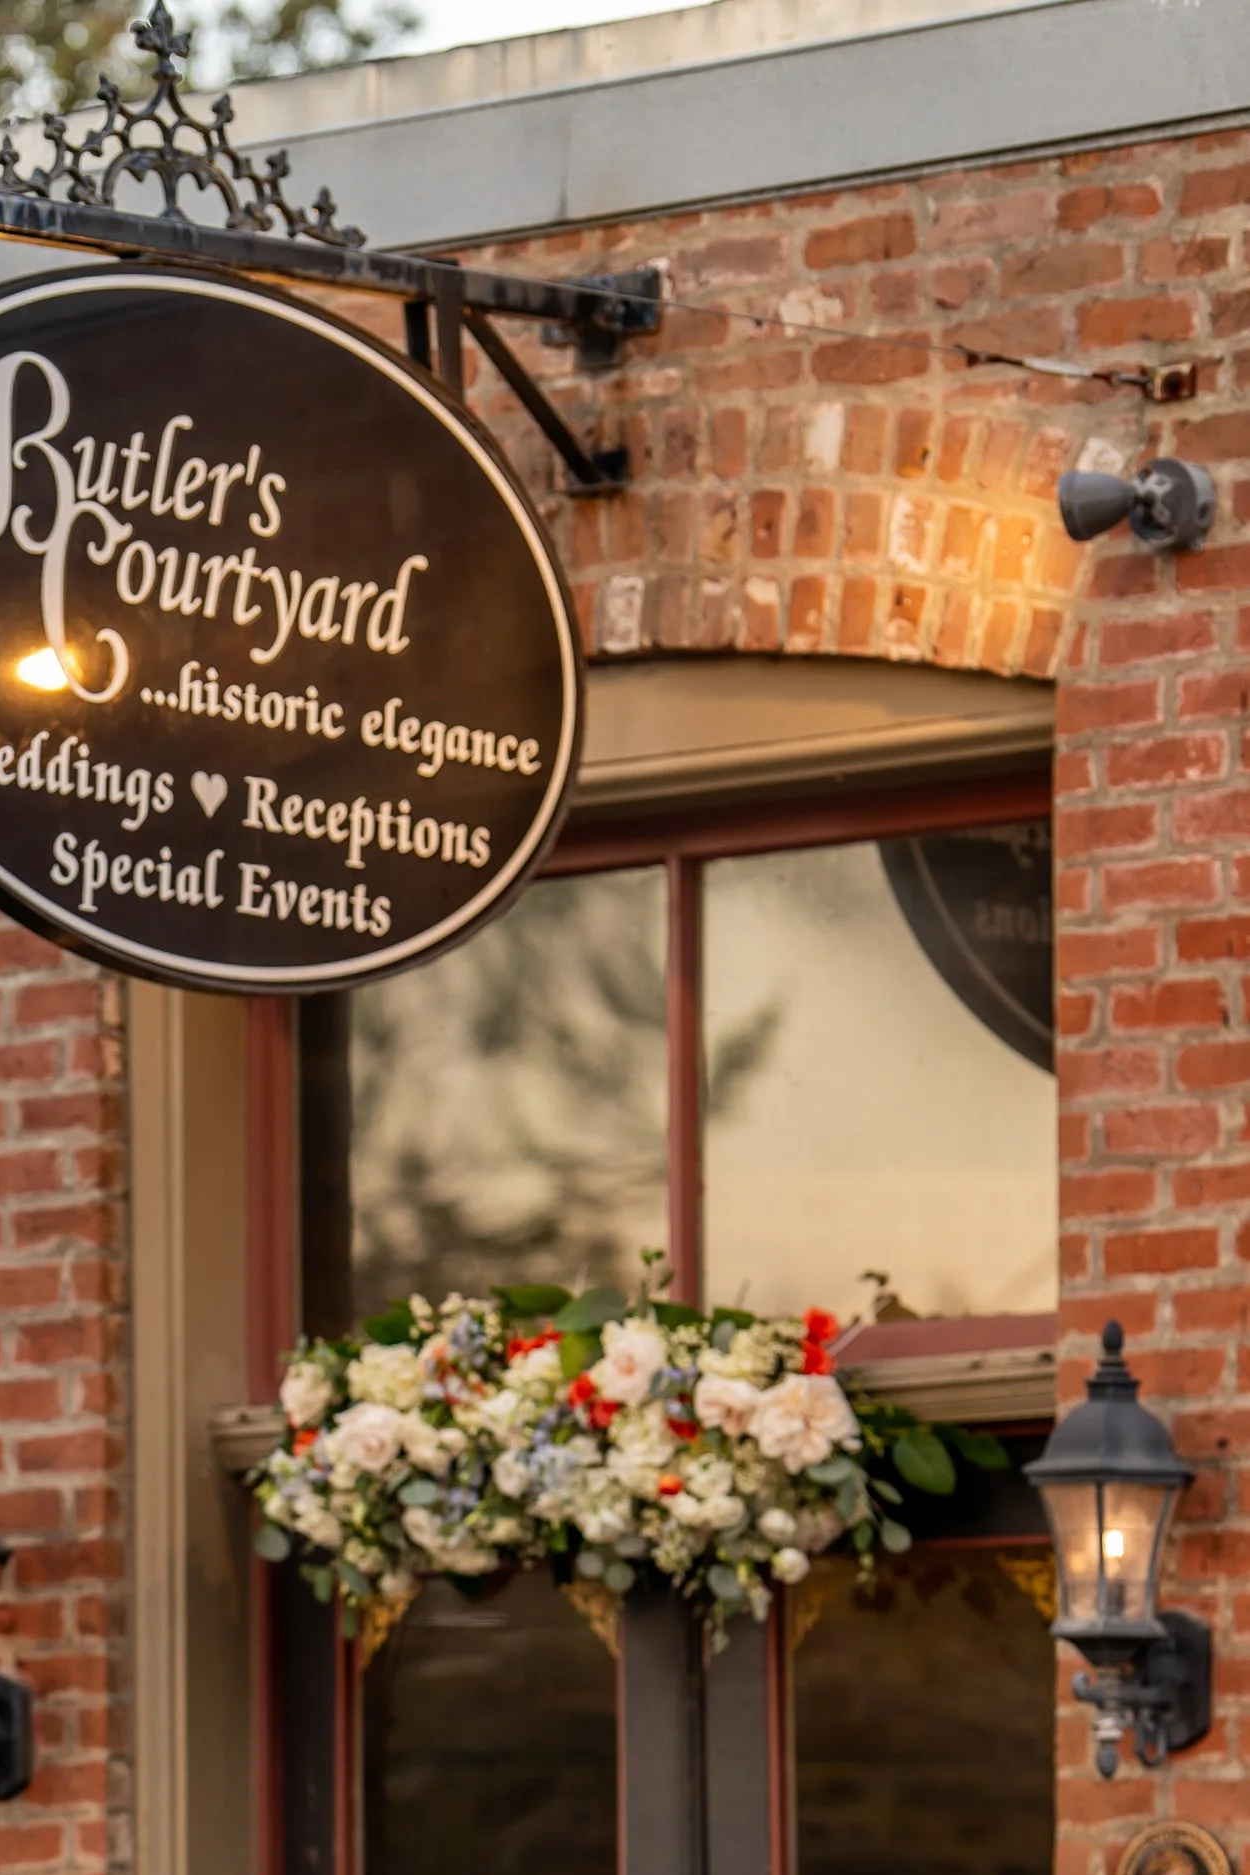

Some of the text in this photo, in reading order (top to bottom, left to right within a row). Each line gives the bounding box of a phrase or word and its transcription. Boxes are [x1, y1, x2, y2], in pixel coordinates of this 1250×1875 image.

[41, 500, 430, 704] Courtyard
[361, 697, 541, 778] elegance
[242, 776, 491, 869] Receptions
[50, 831, 391, 937] Special Events
